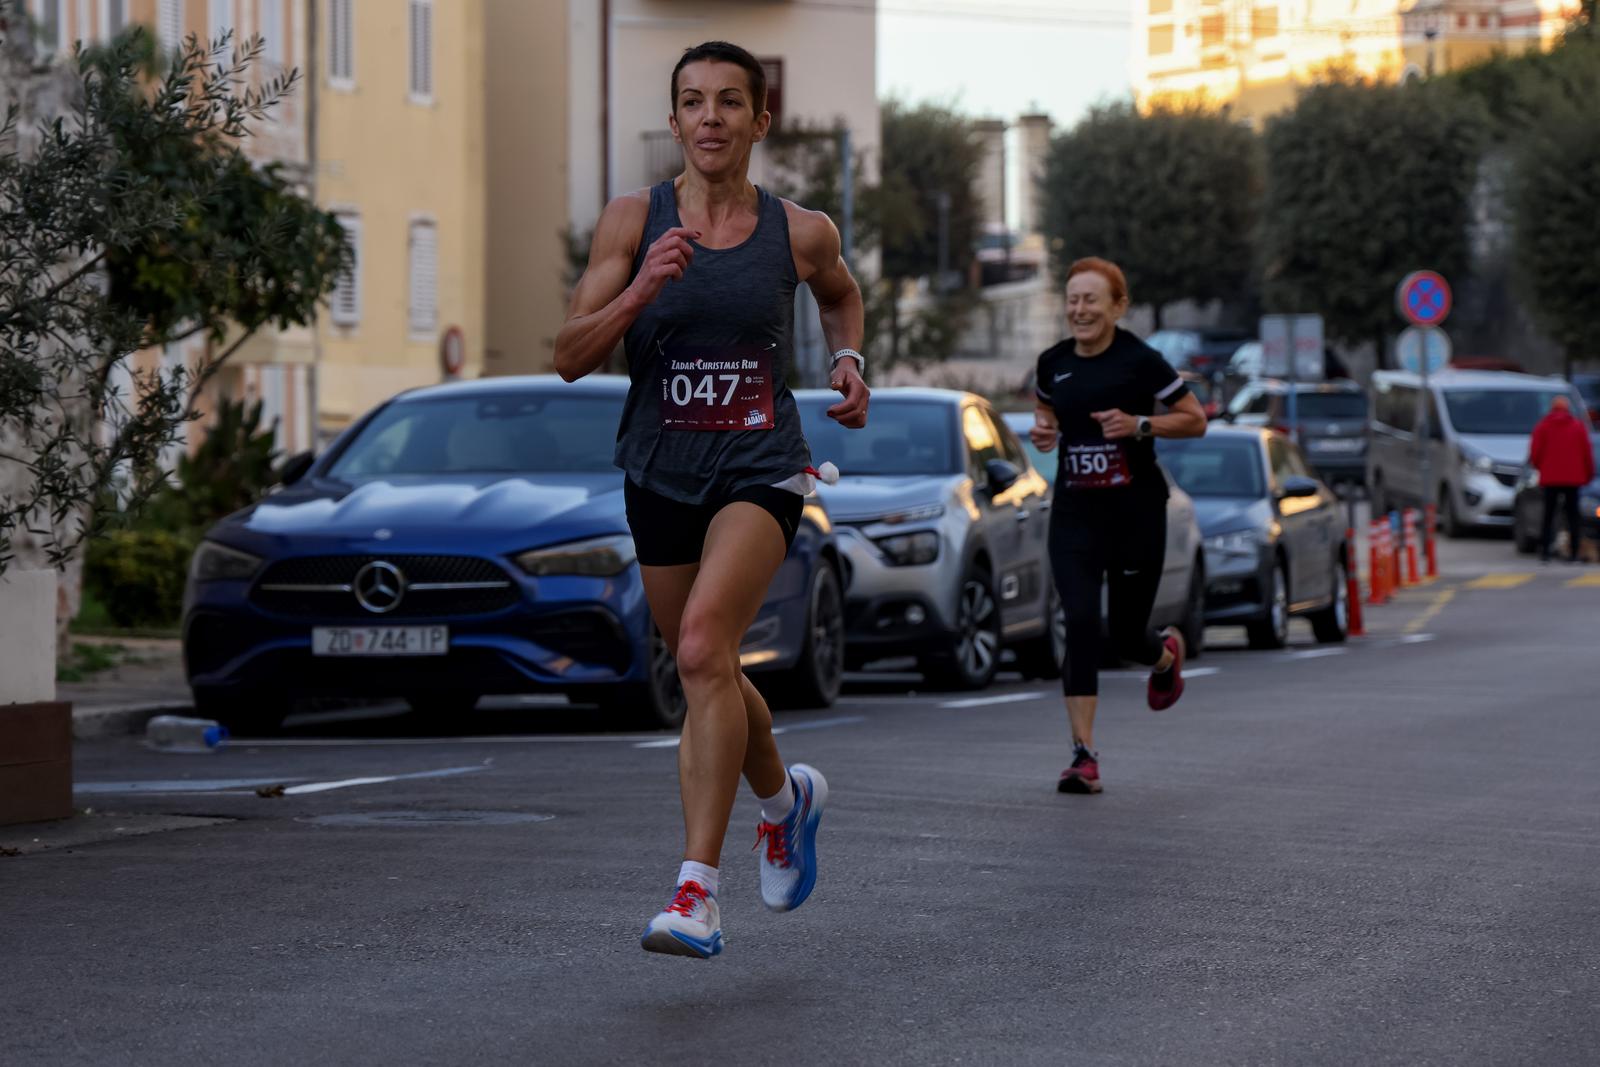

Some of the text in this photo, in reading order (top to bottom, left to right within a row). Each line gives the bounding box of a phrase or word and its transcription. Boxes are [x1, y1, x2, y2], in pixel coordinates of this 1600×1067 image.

[671, 359, 758, 370] ZADAR CHRISTMAS RUN
[671, 374, 740, 406] 047
[1069, 453, 1108, 475] 150
[328, 629, 351, 652] ZD
